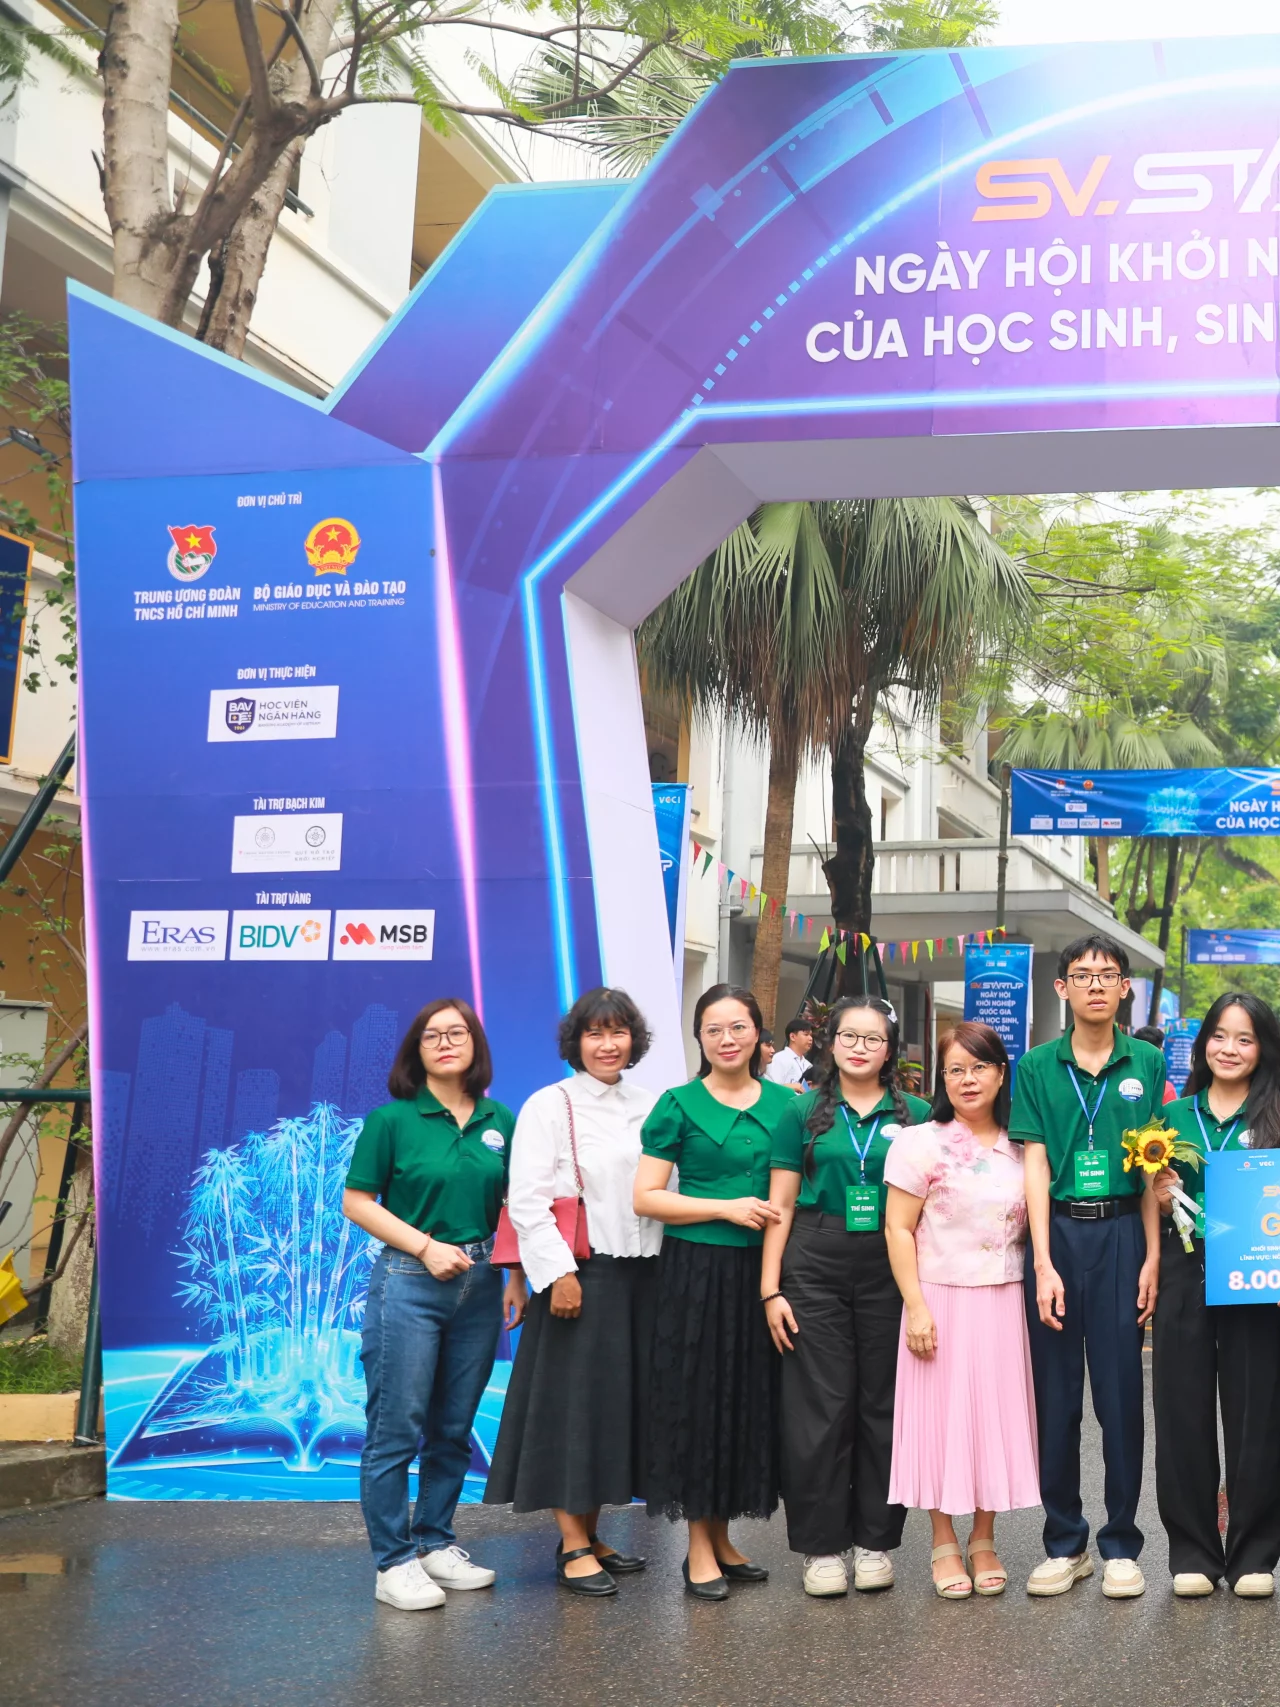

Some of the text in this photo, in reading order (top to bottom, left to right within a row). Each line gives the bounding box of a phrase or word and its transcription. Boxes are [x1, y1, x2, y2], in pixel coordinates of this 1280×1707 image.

[855, 241, 990, 296] NGÀY
[1005, 238, 1091, 296] HỘI
[1109, 229, 1229, 283] KHỞI
[806, 310, 909, 362] CỦA
[924, 311, 1034, 365] HỌC
[1049, 306, 1178, 353] SINH,
[237, 491, 302, 508] ĐƠN VỊ CHỦ TRÌ
[134, 586, 241, 604] TRUNG ƯƠNG ĐOÀN
[253, 579, 406, 601] BỘ GIÁO DỤC VÀ ĐÀO TẠO
[134, 603, 238, 620] TNCS HỒ CHÍ MINH
[253, 597, 405, 611] MINISTRY OF EDUCATION AND TRAINING
[237, 664, 316, 681] ĐƠN VỊ THỰC HIỆN
[229, 702, 253, 711] BAV
[253, 796, 325, 812] TÀI TRỢ BẠCH KIM
[659, 796, 681, 804] VCCI
[1230, 798, 1267, 813] NGÀY
[1216, 814, 1245, 829] CỦA
[1249, 816, 1280, 831] HỌC
[256, 891, 311, 906] TÀI TRỢ VÀNG
[239, 924, 300, 948] BIDV
[380, 924, 428, 943] MSB
